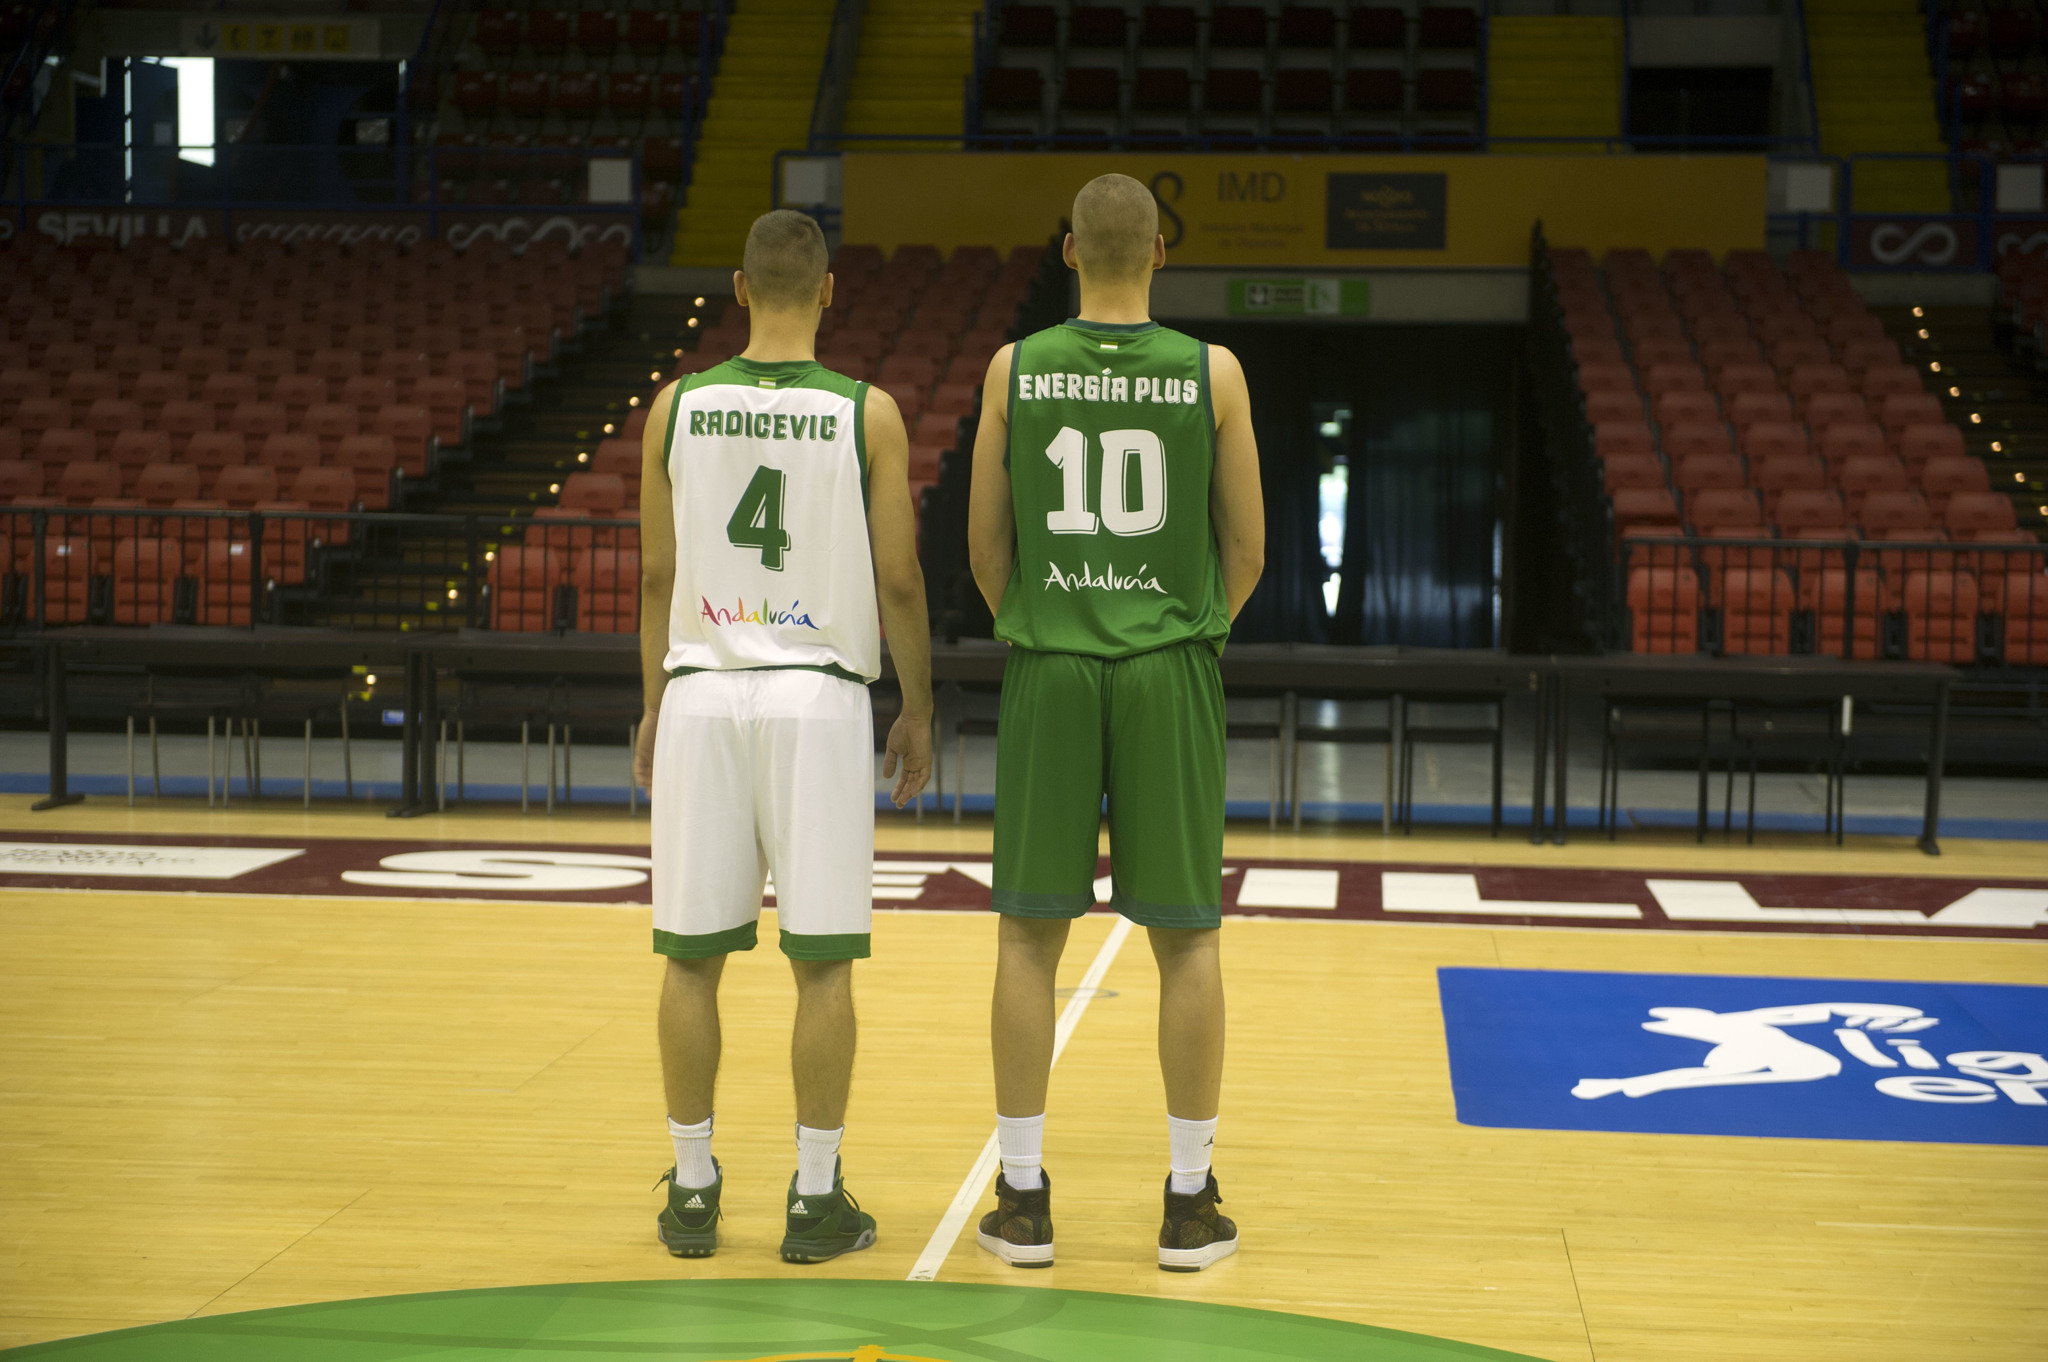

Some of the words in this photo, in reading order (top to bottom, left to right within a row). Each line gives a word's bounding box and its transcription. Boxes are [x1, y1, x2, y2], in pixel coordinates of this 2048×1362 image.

[1216, 171, 1286, 203] IMD
[1018, 367, 1129, 402] ENERGÍA
[1134, 376, 1199, 405] PLUS
[689, 409, 837, 441] RADICEVIC
[1045, 426, 1168, 537] 10
[726, 464, 792, 572] 4
[1043, 560, 1169, 595] Andalucía
[700, 595, 820, 630] Andalucía
